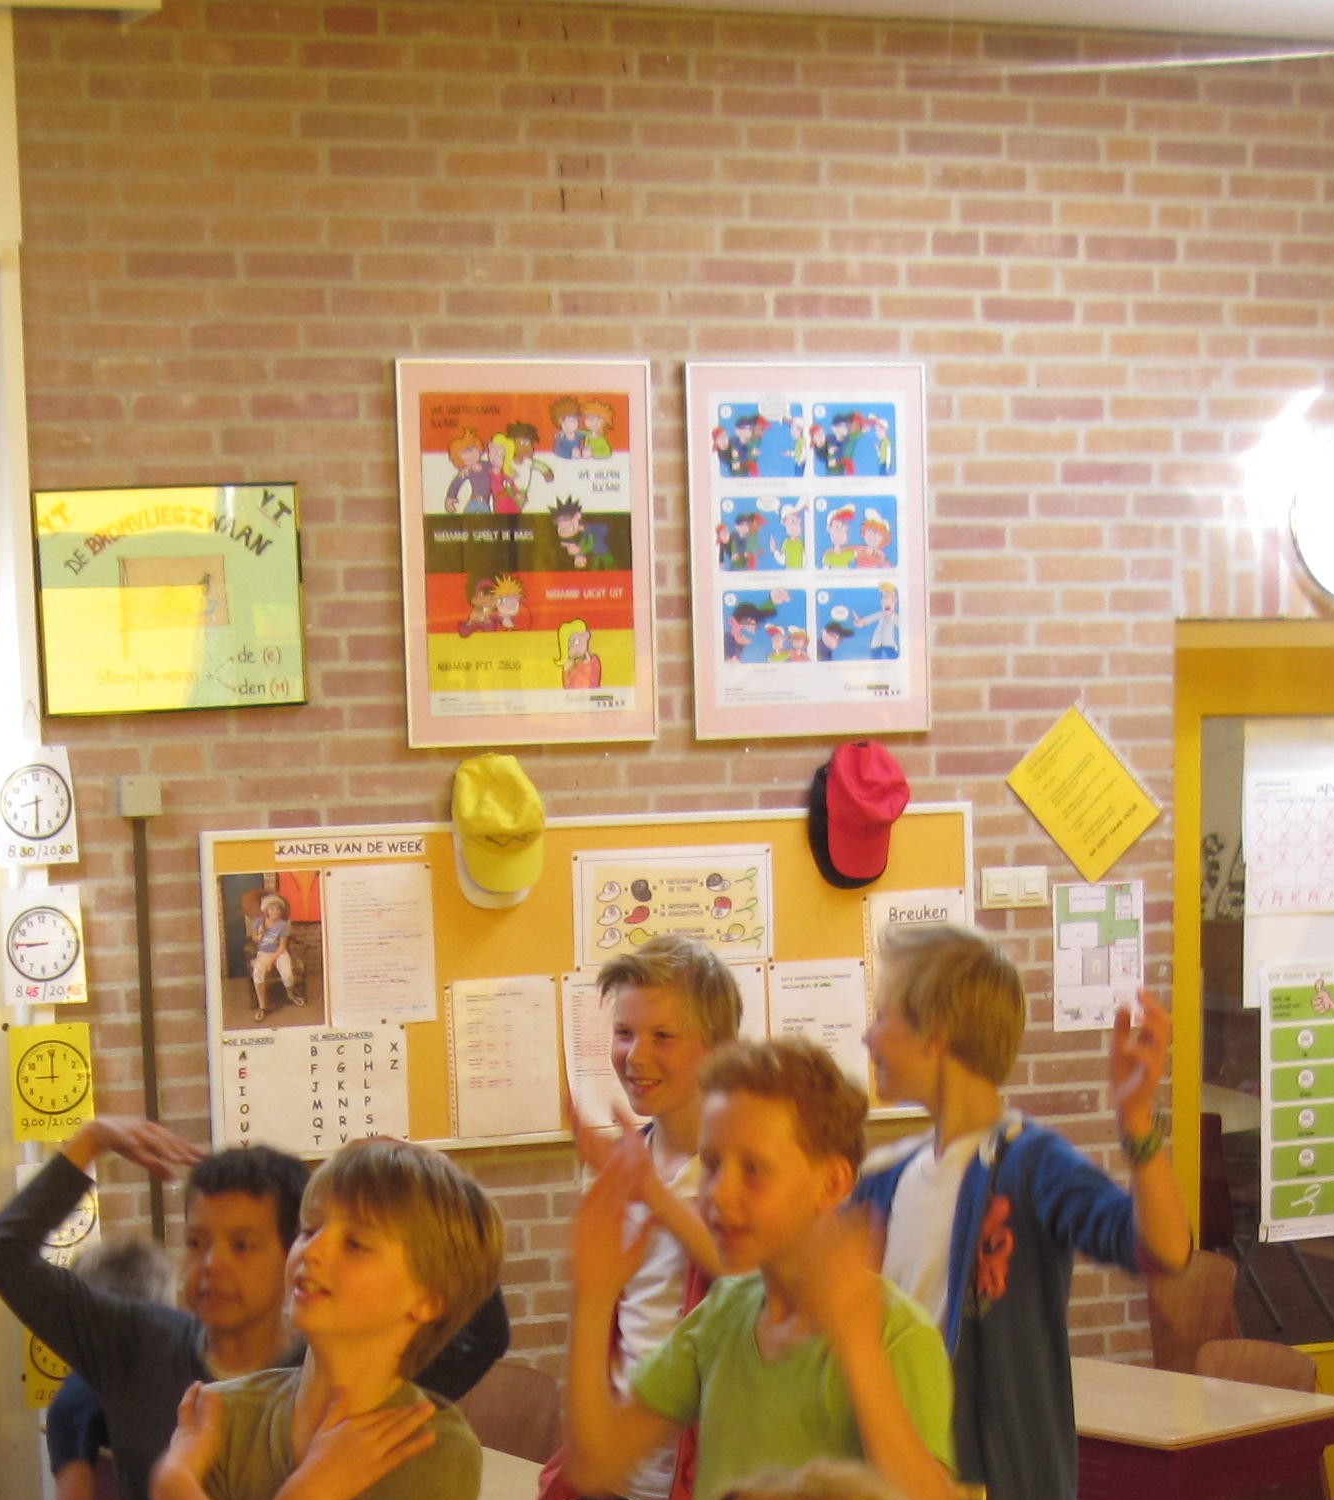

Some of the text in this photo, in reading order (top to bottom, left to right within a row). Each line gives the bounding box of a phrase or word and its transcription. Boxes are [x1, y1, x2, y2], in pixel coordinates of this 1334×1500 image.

[64, 550, 90, 576] DE
[238, 645, 255, 664] de
[238, 678, 265, 696] den
[278, 839, 423, 856] KANJER VAN DE WEEK
[889, 905, 948, 922] Breuken
[310, 1046, 318, 1057] B
[336, 1045, 345, 1055] C
[364, 1044, 372, 1054] D
[390, 1042, 399, 1052] X
[238, 1051, 247, 1061] A
[310, 1064, 318, 1075] F
[337, 1062, 346, 1073] G
[364, 1061, 373, 1071] H
[390, 1060, 399, 1070] Z
[239, 1067, 247, 1079] E
[311, 1081, 319, 1093] J
[337, 1080, 345, 1091] K
[364, 1079, 371, 1089] L
[239, 1086, 246, 1097] I
[312, 1099, 323, 1110] M
[338, 1097, 348, 1108] N
[364, 1096, 371, 1107] P
[240, 1103, 250, 1115] O
[312, 1117, 324, 1129] Q
[339, 1115, 347, 1126] R
[366, 1114, 374, 1125] S
[240, 1121, 249, 1133] U
[313, 1135, 322, 1145] T
[340, 1133, 348, 1144] V
